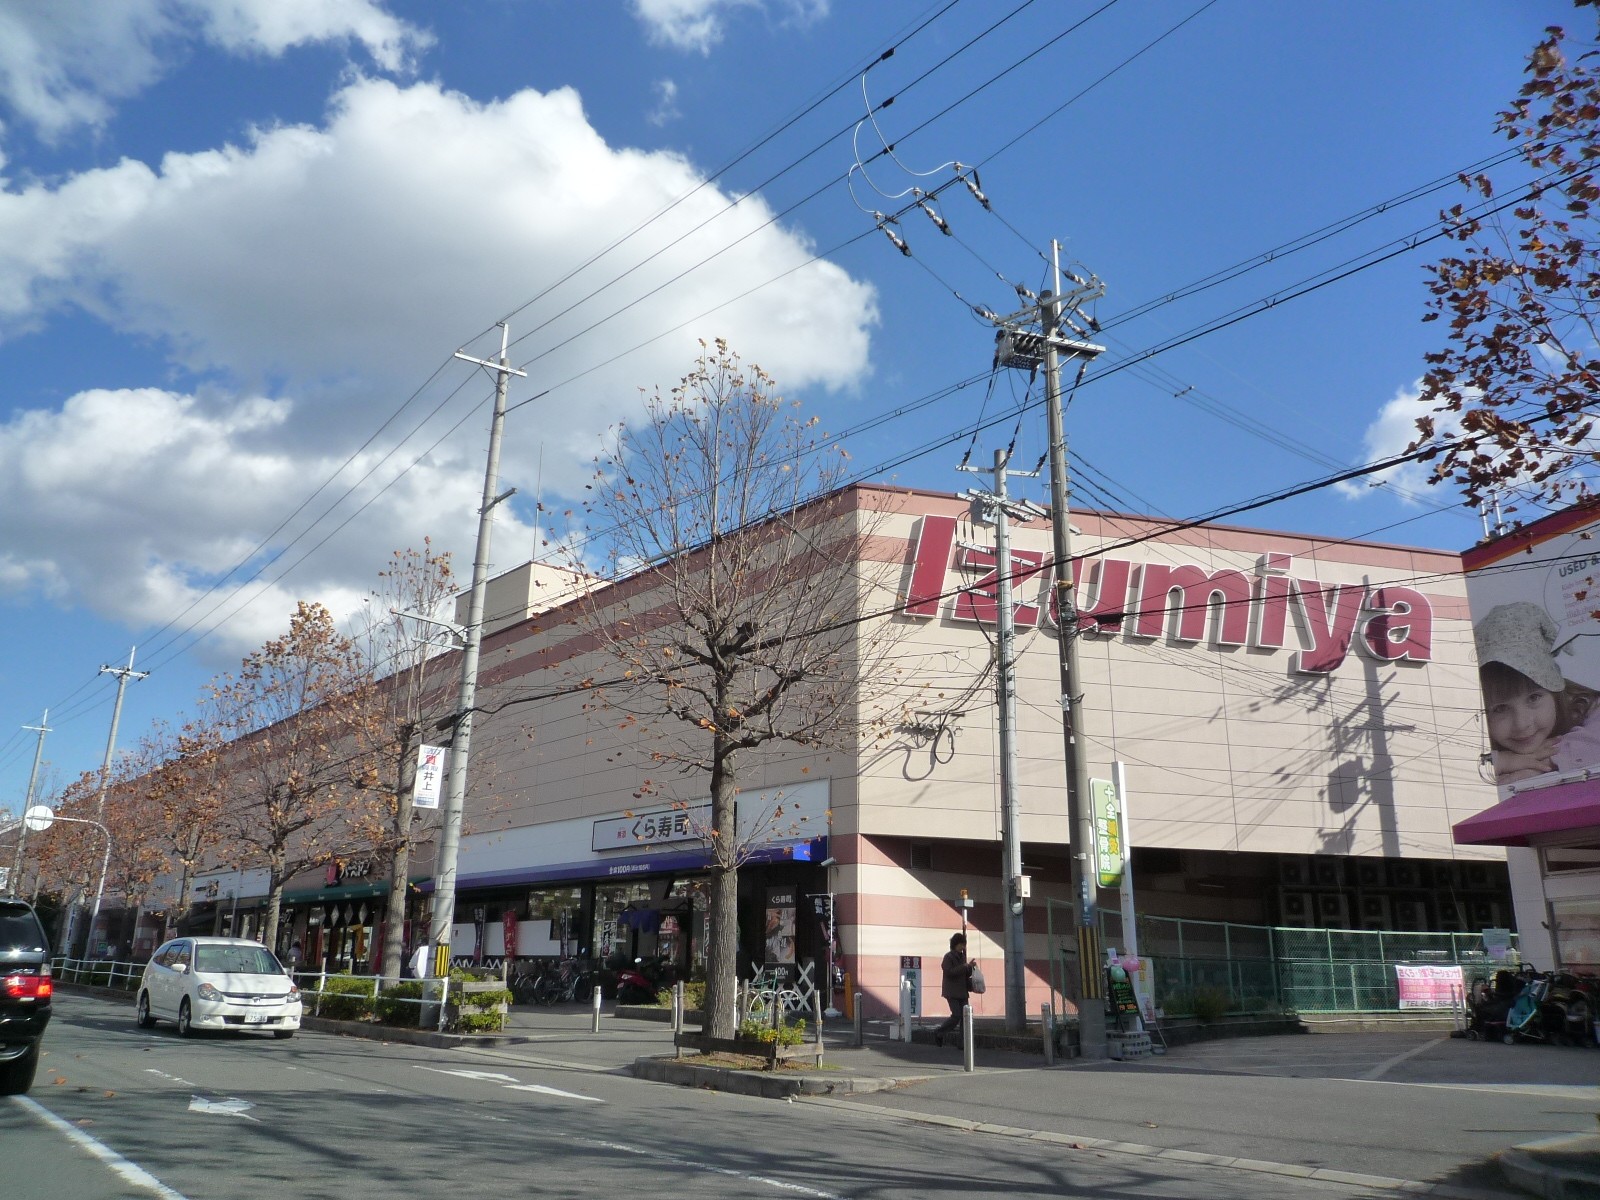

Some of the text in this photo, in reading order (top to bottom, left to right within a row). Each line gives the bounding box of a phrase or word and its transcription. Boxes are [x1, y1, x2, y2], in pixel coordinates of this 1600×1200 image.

[1558, 561, 1587, 577] USED
[902, 513, 1434, 674] Izumiya
[422, 771, 435, 791] 井上
[631, 813, 689, 841] くら寿司
